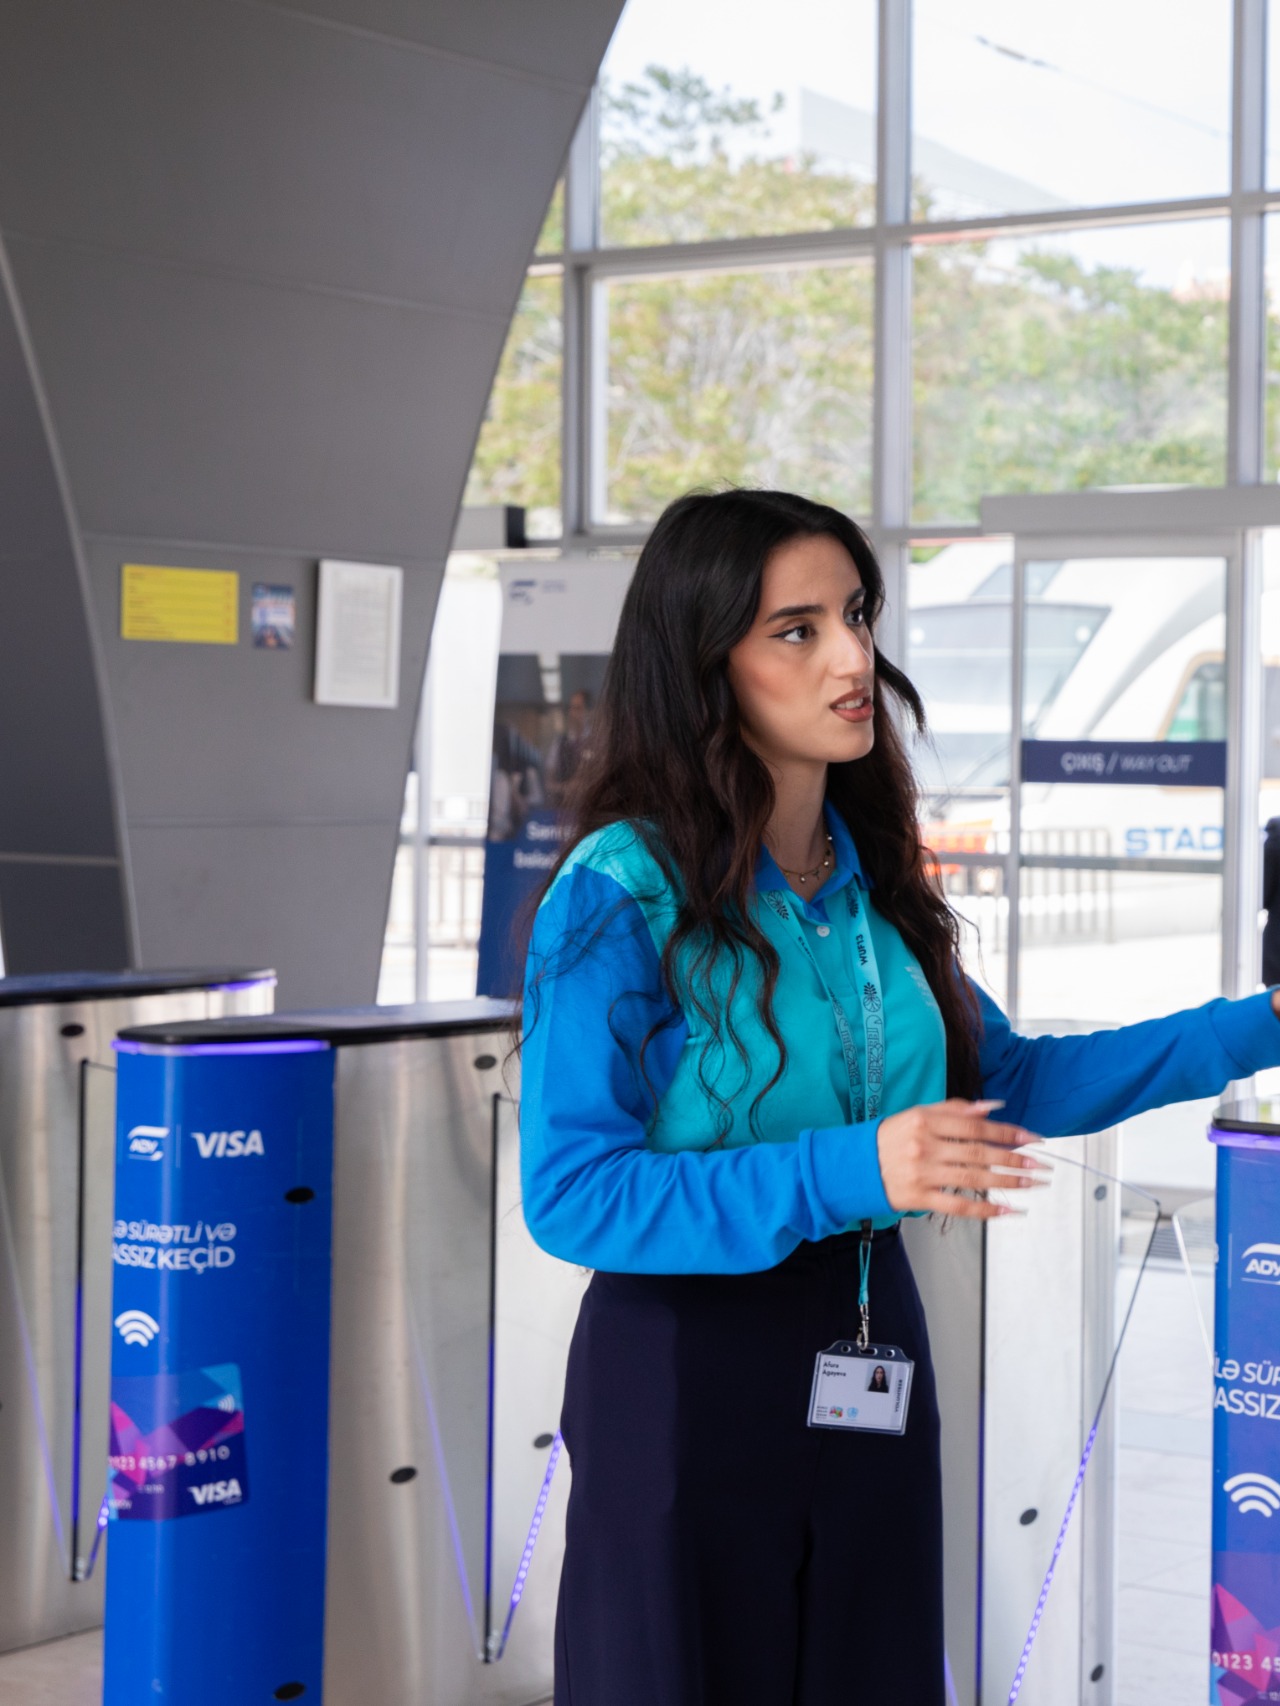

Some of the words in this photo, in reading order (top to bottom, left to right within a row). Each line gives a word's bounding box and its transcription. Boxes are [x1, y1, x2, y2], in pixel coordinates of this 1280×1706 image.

[1156, 754, 1194, 774] OUT
[856, 934, 868, 966] WUF13
[191, 1130, 265, 1158] VISA
[205, 1223, 237, 1242] VƏ
[157, 1241, 236, 1275] KEÇİD
[184, 1445, 231, 1467] 8910
[187, 1478, 242, 1505] VISA
[1212, 1650, 1253, 1671] 0123
